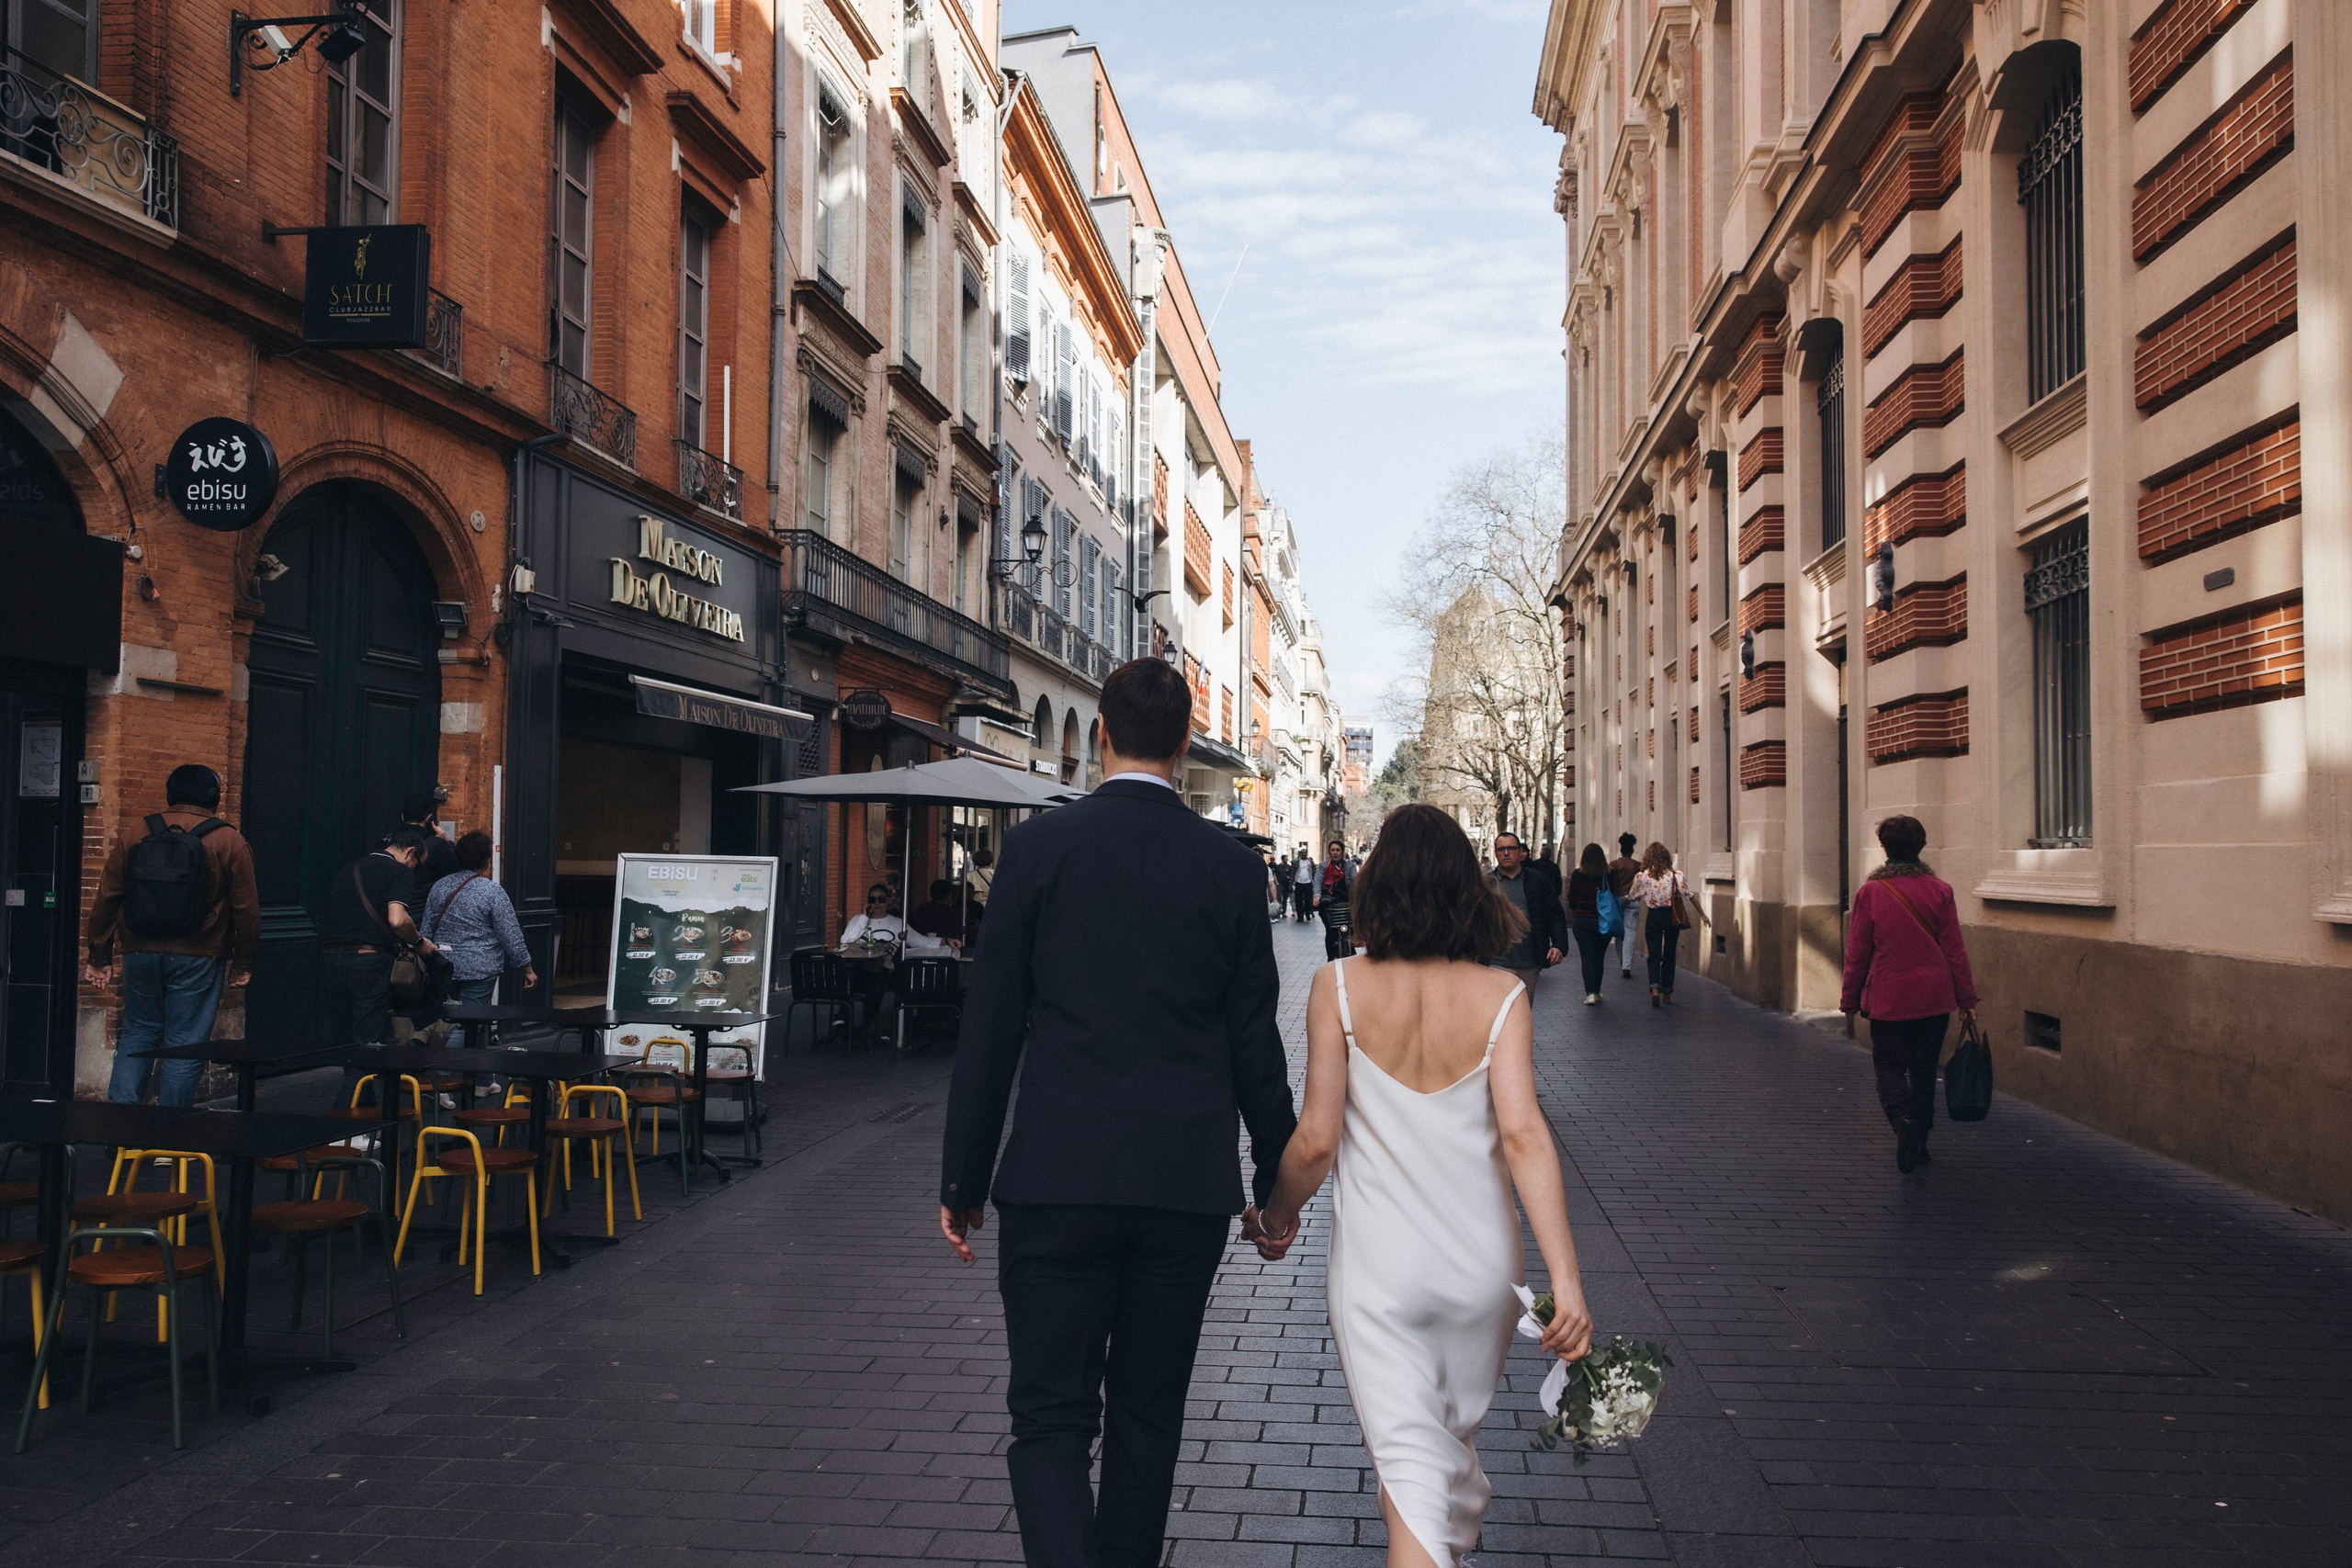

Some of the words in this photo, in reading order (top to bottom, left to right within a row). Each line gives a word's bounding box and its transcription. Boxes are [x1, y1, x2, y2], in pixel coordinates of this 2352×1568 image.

[329, 284, 391, 305] SATCH
[188, 435, 247, 473] えびす
[187, 479, 246, 501] ebisu
[678, 695, 721, 727] MAISON
[724, 704, 739, 728] DE
[741, 707, 786, 738] OLIVEIRA
[846, 704, 888, 716] MATHILDE
[1035, 759, 1057, 776] STARBUCKS
